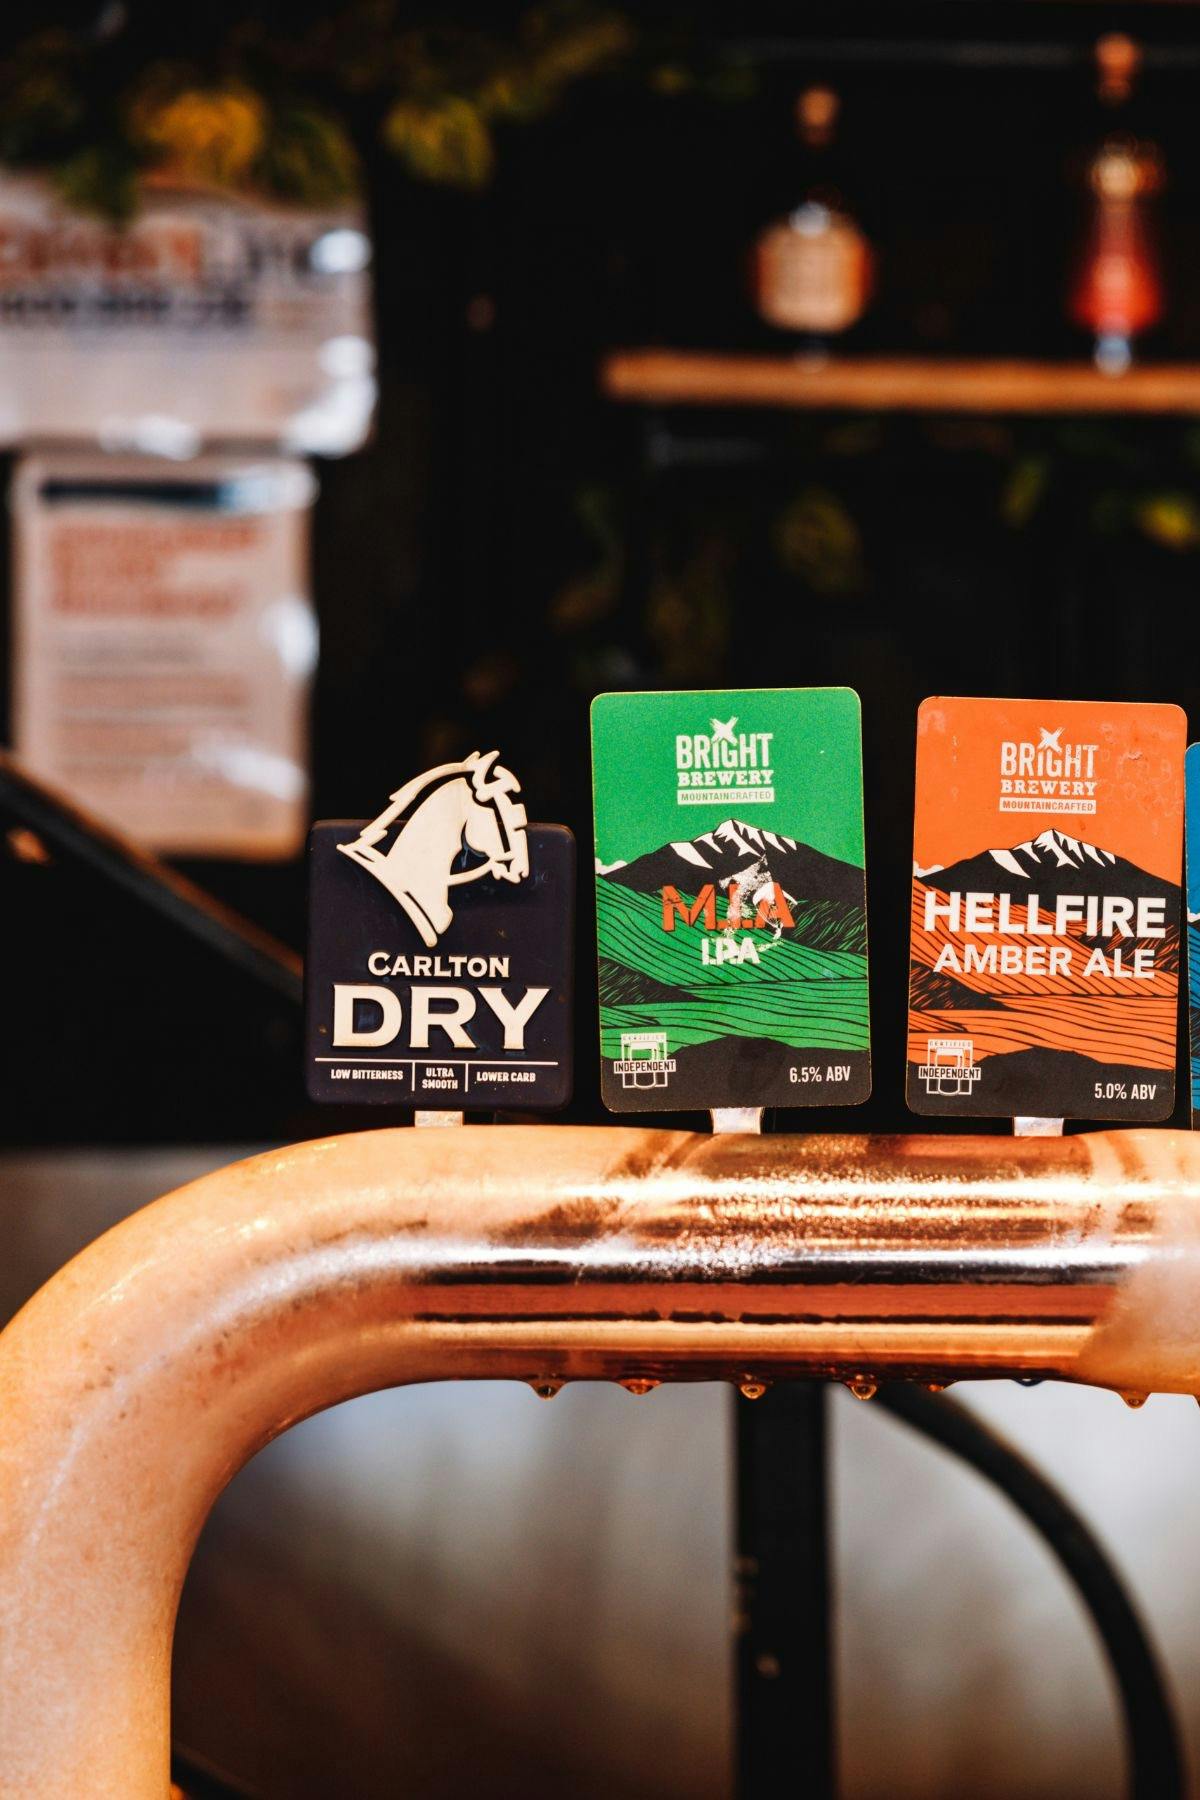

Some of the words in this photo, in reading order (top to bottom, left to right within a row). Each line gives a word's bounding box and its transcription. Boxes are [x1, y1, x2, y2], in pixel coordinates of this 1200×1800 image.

[676, 733, 773, 770] BRIGHT
[1001, 741, 1099, 779] BRIGHT
[676, 769, 774, 787] BREWERY
[680, 790, 772, 802] MOUNTAINCRAFTED
[1000, 778, 1098, 797] BREWERY
[1002, 800, 1094, 812] MOUNTAINCRAFTED
[923, 891, 1167, 939] HELLFIRE
[367, 951, 511, 978] CARLTON
[932, 943, 1073, 977] AMBER
[1082, 947, 1157, 979] ALE
[332, 983, 551, 1050] DRY
[330, 1068, 351, 1080] LOW
[352, 1069, 404, 1081] BITTERNESS
[425, 1067, 455, 1078] ULTRA
[614, 1060, 676, 1073] INDEPENDENT
[789, 1067, 822, 1083] 6.5%
[826, 1066, 851, 1082] ABV
[919, 1066, 981, 1080] INDEPENDENT
[421, 1078, 459, 1089] SMOOTH
[476, 1071, 509, 1082] LOWER
[510, 1072, 537, 1083] CARB
[1094, 1083, 1127, 1100] 5.0%
[1130, 1084, 1157, 1100] ABV
